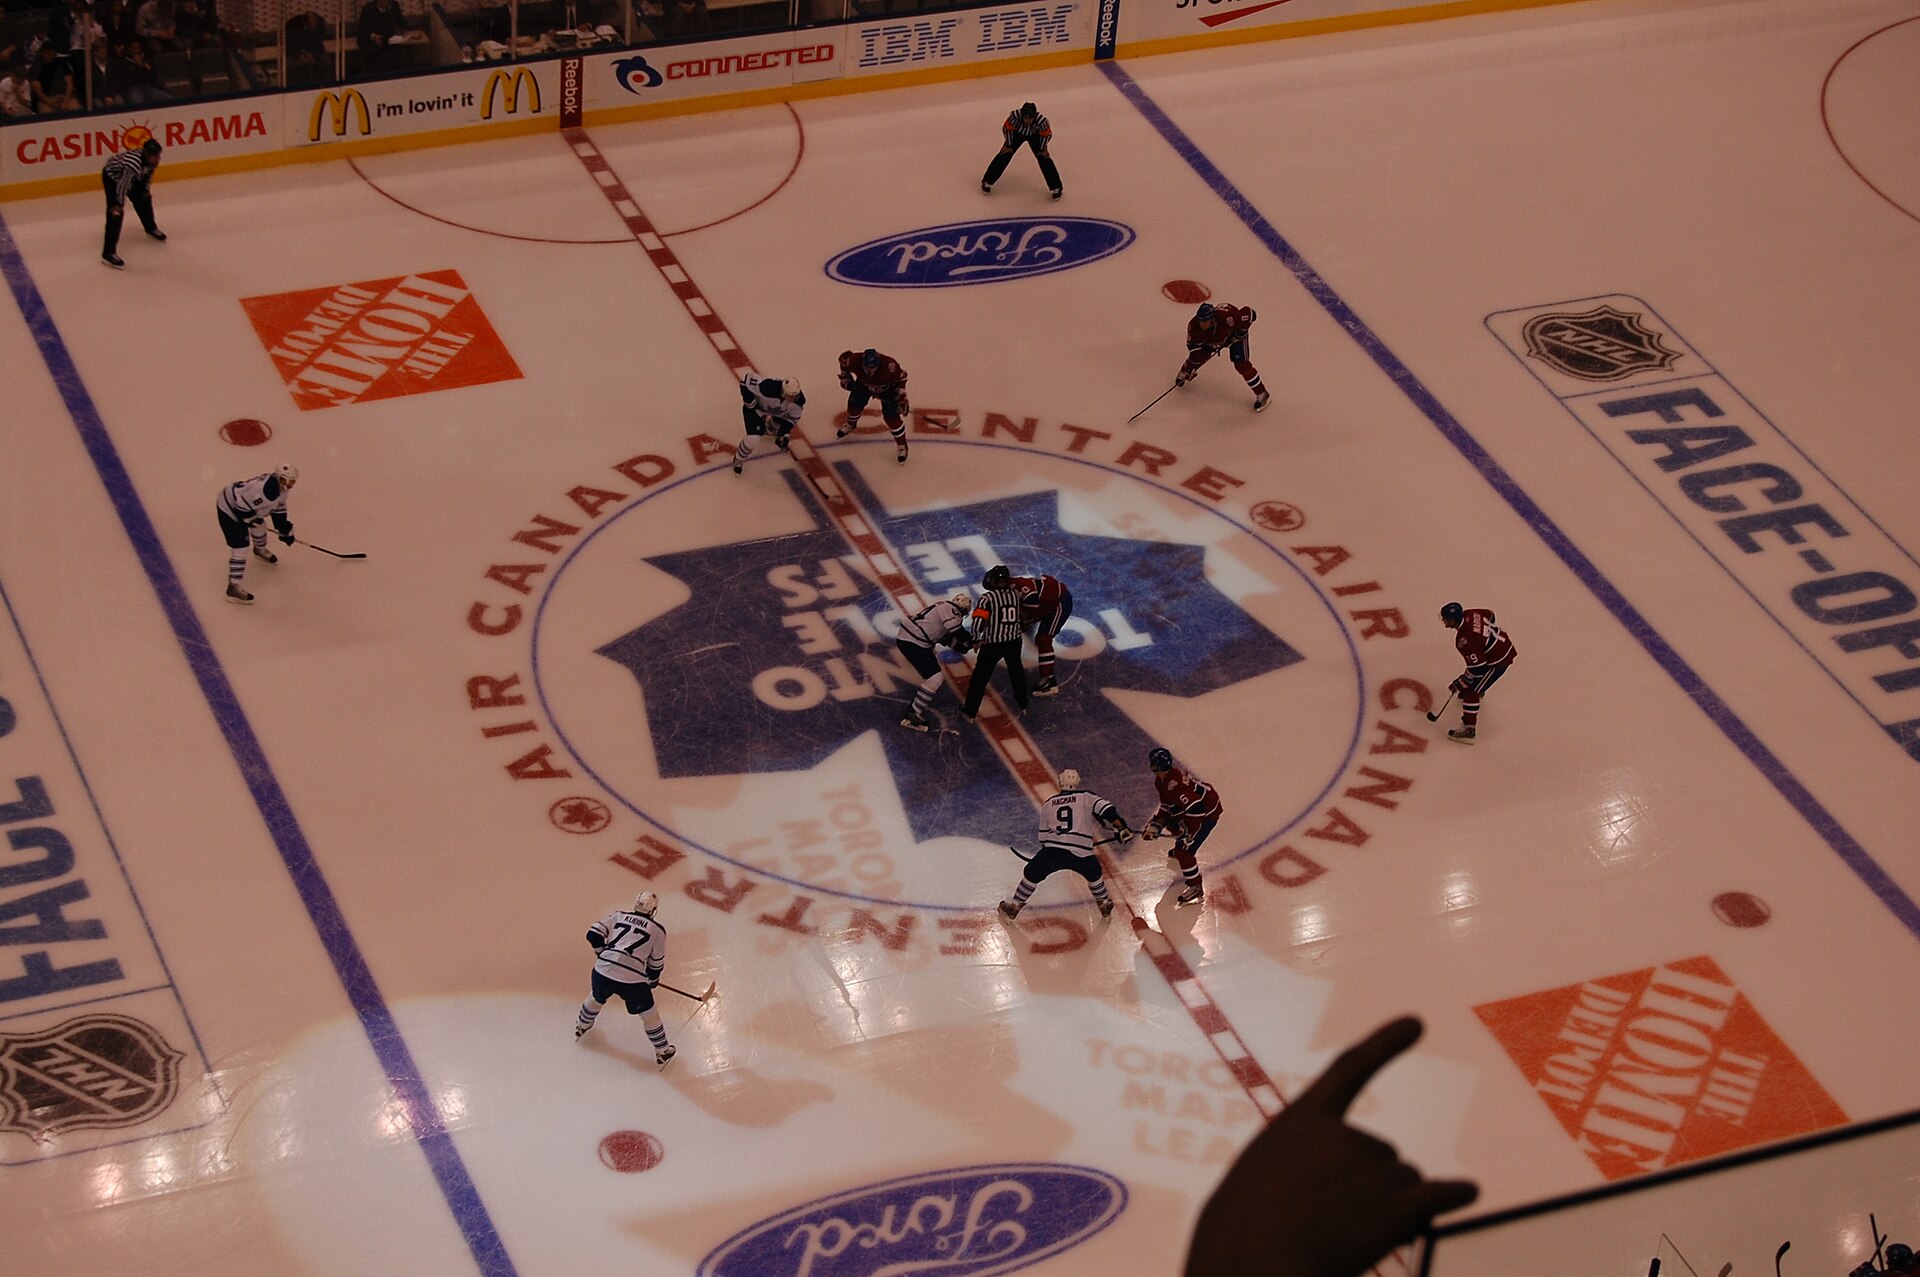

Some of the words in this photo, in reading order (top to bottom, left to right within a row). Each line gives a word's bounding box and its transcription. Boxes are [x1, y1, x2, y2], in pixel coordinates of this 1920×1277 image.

[859, 18, 958, 68] IBM
[976, 3, 1074, 54] IBM
[377, 102, 403, 118] i'm
[409, 94, 457, 114] lovin'
[461, 92, 475, 107] it
[564, 59, 579, 115] Reebok
[166, 112, 267, 147] RAMA
[887, 225, 1067, 275] Ford
[1547, 328, 1640, 364] NHL
[468, 433, 738, 636] CANADA
[1002, 606, 1016, 623] 10
[1292, 544, 1411, 643] AIR
[467, 673, 573, 781] AIR
[1056, 805, 1073, 834] 9
[1205, 677, 1434, 916] CANADA
[607, 922, 651, 955] 77
[30, 1047, 148, 1101] NHL
